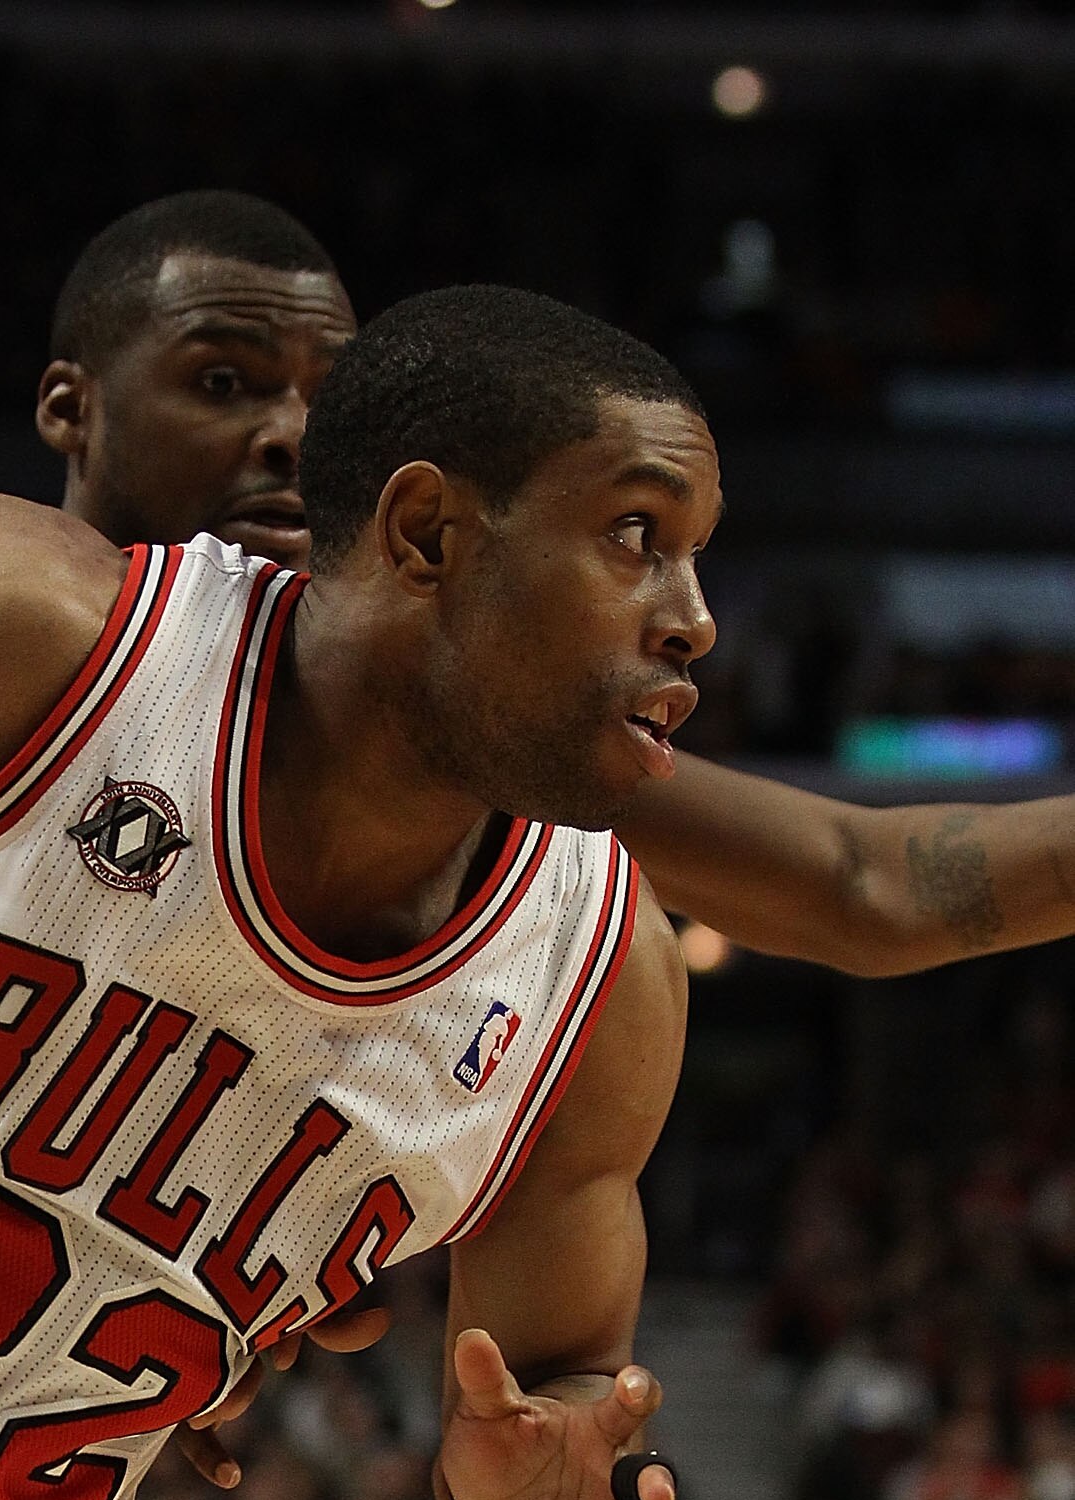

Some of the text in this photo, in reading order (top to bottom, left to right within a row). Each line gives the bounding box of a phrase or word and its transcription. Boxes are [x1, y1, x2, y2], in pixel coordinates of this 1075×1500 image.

[127, 784, 180, 826] ANNIVERSARY
[92, 862, 161, 889] CHAMPIONSHIP
[456, 1062, 479, 1086] NBA
